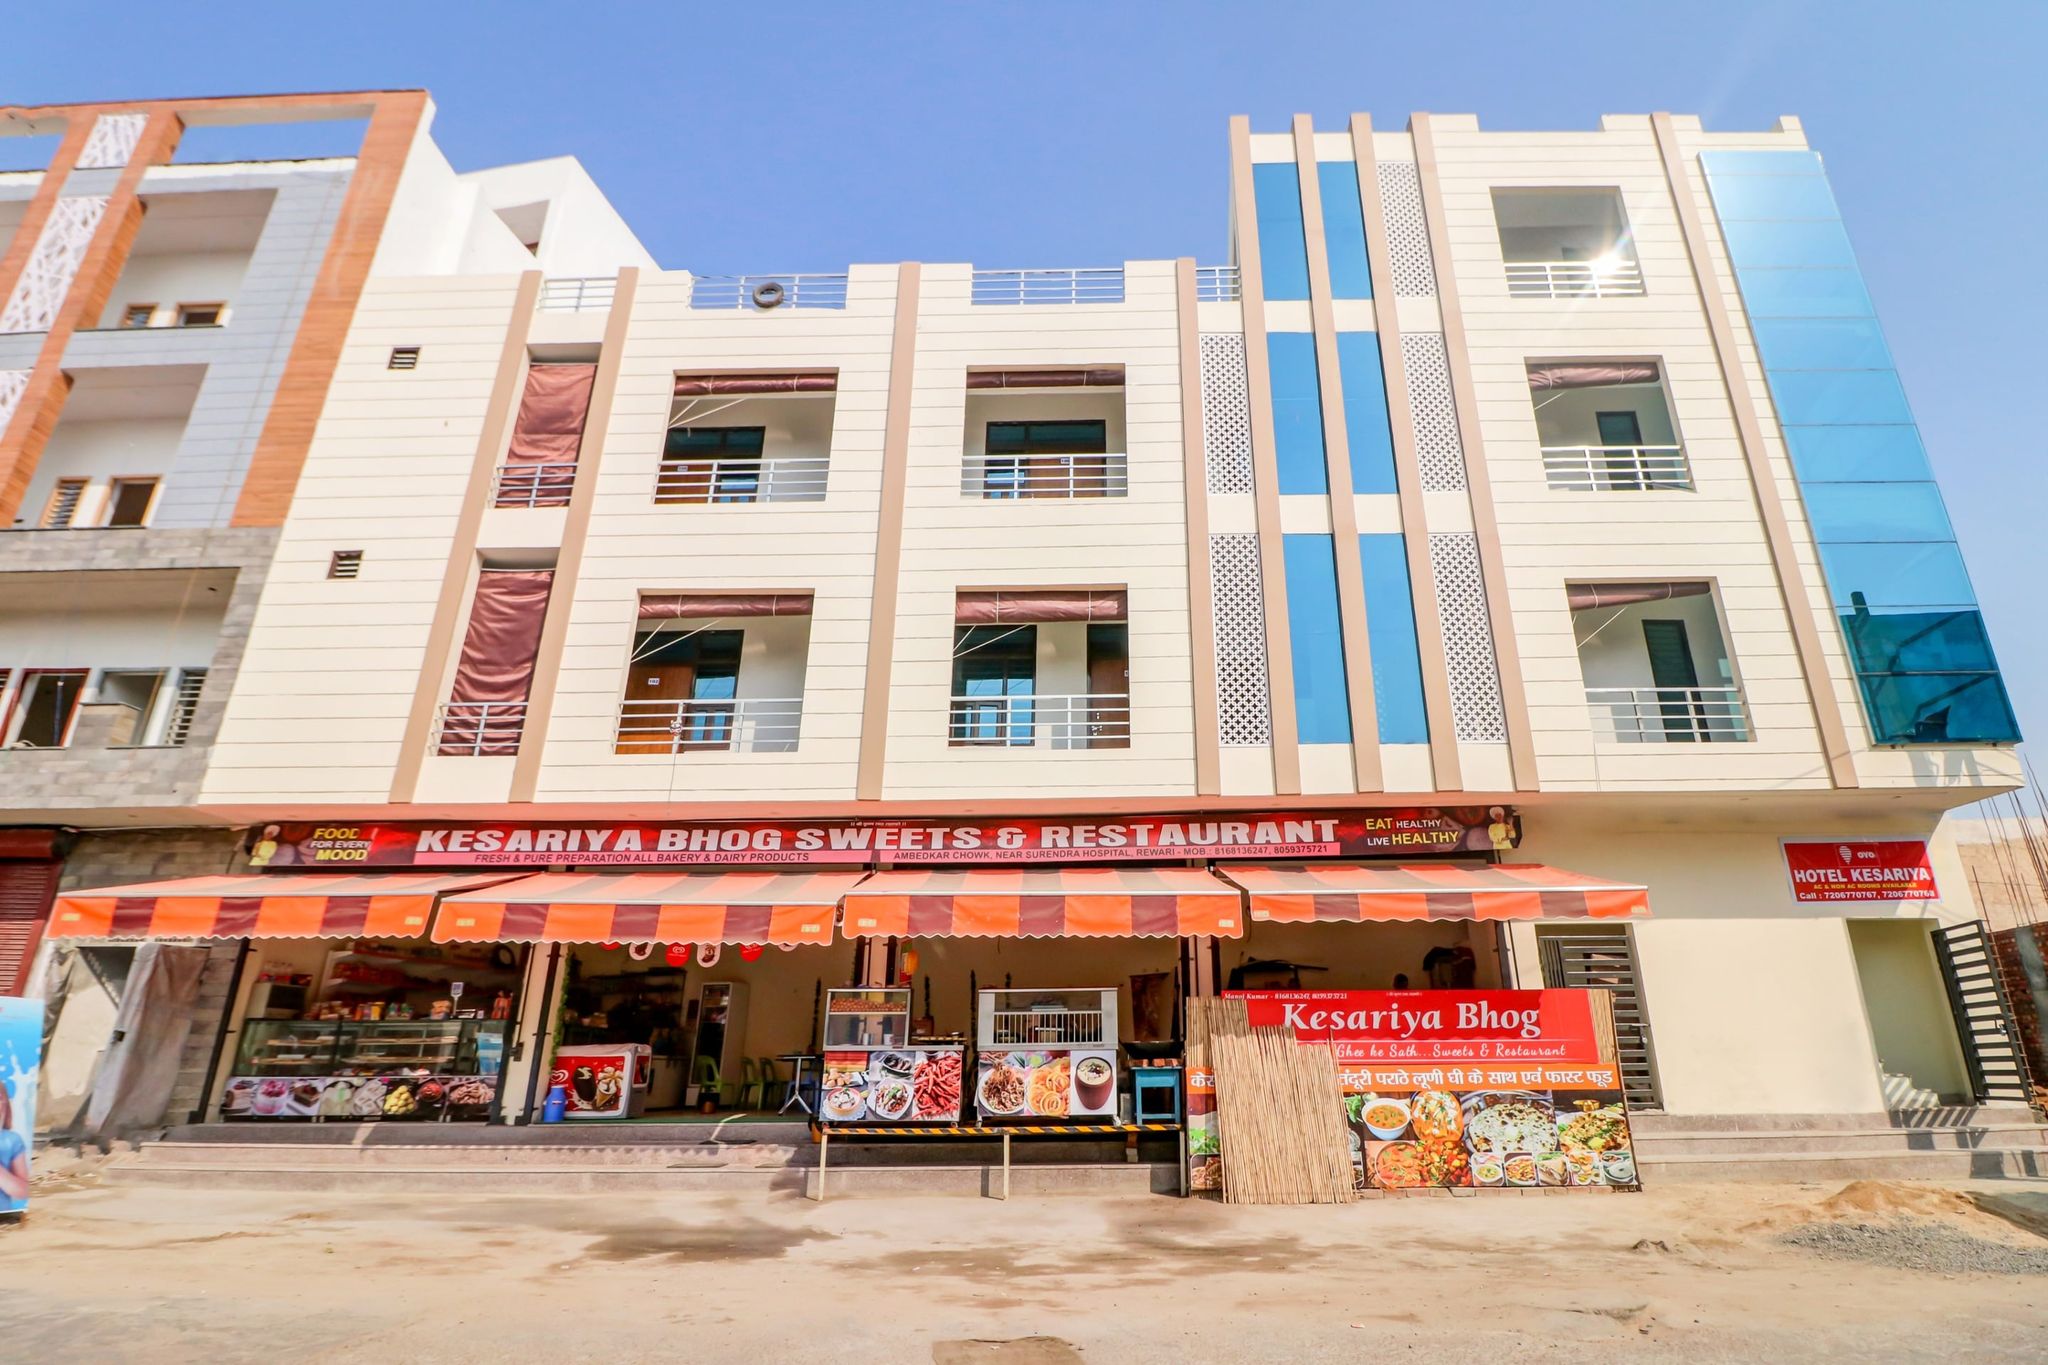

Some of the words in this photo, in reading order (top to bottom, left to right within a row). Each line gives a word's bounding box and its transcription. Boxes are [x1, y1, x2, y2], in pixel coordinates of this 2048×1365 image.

[1365, 818, 1393, 830] EAT
[1396, 819, 1442, 829] HEALTHY
[313, 828, 361, 839] FOOD
[415, 829, 642, 852] KESARIYA
[656, 828, 782, 851] BHOG
[794, 827, 982, 850] SWEETS
[996, 826, 1027, 850] &
[1041, 819, 1340, 848] RESTAURANT
[1367, 837, 1390, 846] LIVE
[1391, 831, 1460, 845] HEALTHY
[310, 840, 334, 848] FOR
[335, 840, 372, 849] EVERY
[315, 849, 368, 861] MOOD
[474, 854, 510, 863] FRESH
[513, 854, 521, 863] &
[523, 854, 553, 863] PURE
[556, 853, 632, 863] PREPARATION
[633, 853, 654, 863] ALL
[656, 853, 702, 862] BAKERY
[703, 853, 711, 862] &
[714, 853, 746, 862] DAIRY
[749, 852, 810, 862] PRODUCTS
[894, 851, 950, 860] AMBEDKAR
[952, 851, 993, 860] CHOWK,
[995, 850, 1023, 860] NEAR
[1025, 849, 1081, 859] SURENDRA
[1083, 848, 1134, 858] HOSPITAL,
[1136, 848, 1176, 857] REWARI
[1273, 844, 1328, 854] 8059375721
[1857, 851, 1876, 859] OYO
[1793, 869, 1848, 883] HOTEL
[1851, 867, 1931, 882] KESARIYA
[1800, 891, 1817, 899] Call
[1224, 993, 1245, 1001] Manoj
[1282, 1002, 1443, 1038] Kesariya
[1456, 1000, 1541, 1038] Bhog
[1337, 1043, 1365, 1058] Ghee
[1370, 1043, 1385, 1057] ke
[1479, 1044, 1490, 1057] &
[1495, 1043, 1567, 1057] Restaurant
[1375, 1068, 1409, 1085] पराठे
[1411, 1068, 1444, 1090] लूणी
[1447, 1068, 1464, 1085] घी
[1466, 1068, 1484, 1085] के
[1487, 1070, 1518, 1085] साथ
[1520, 1066, 1543, 1085] एवं
[1545, 1070, 1584, 1084] फास्ट
[1586, 1070, 1613, 1088] फूड
